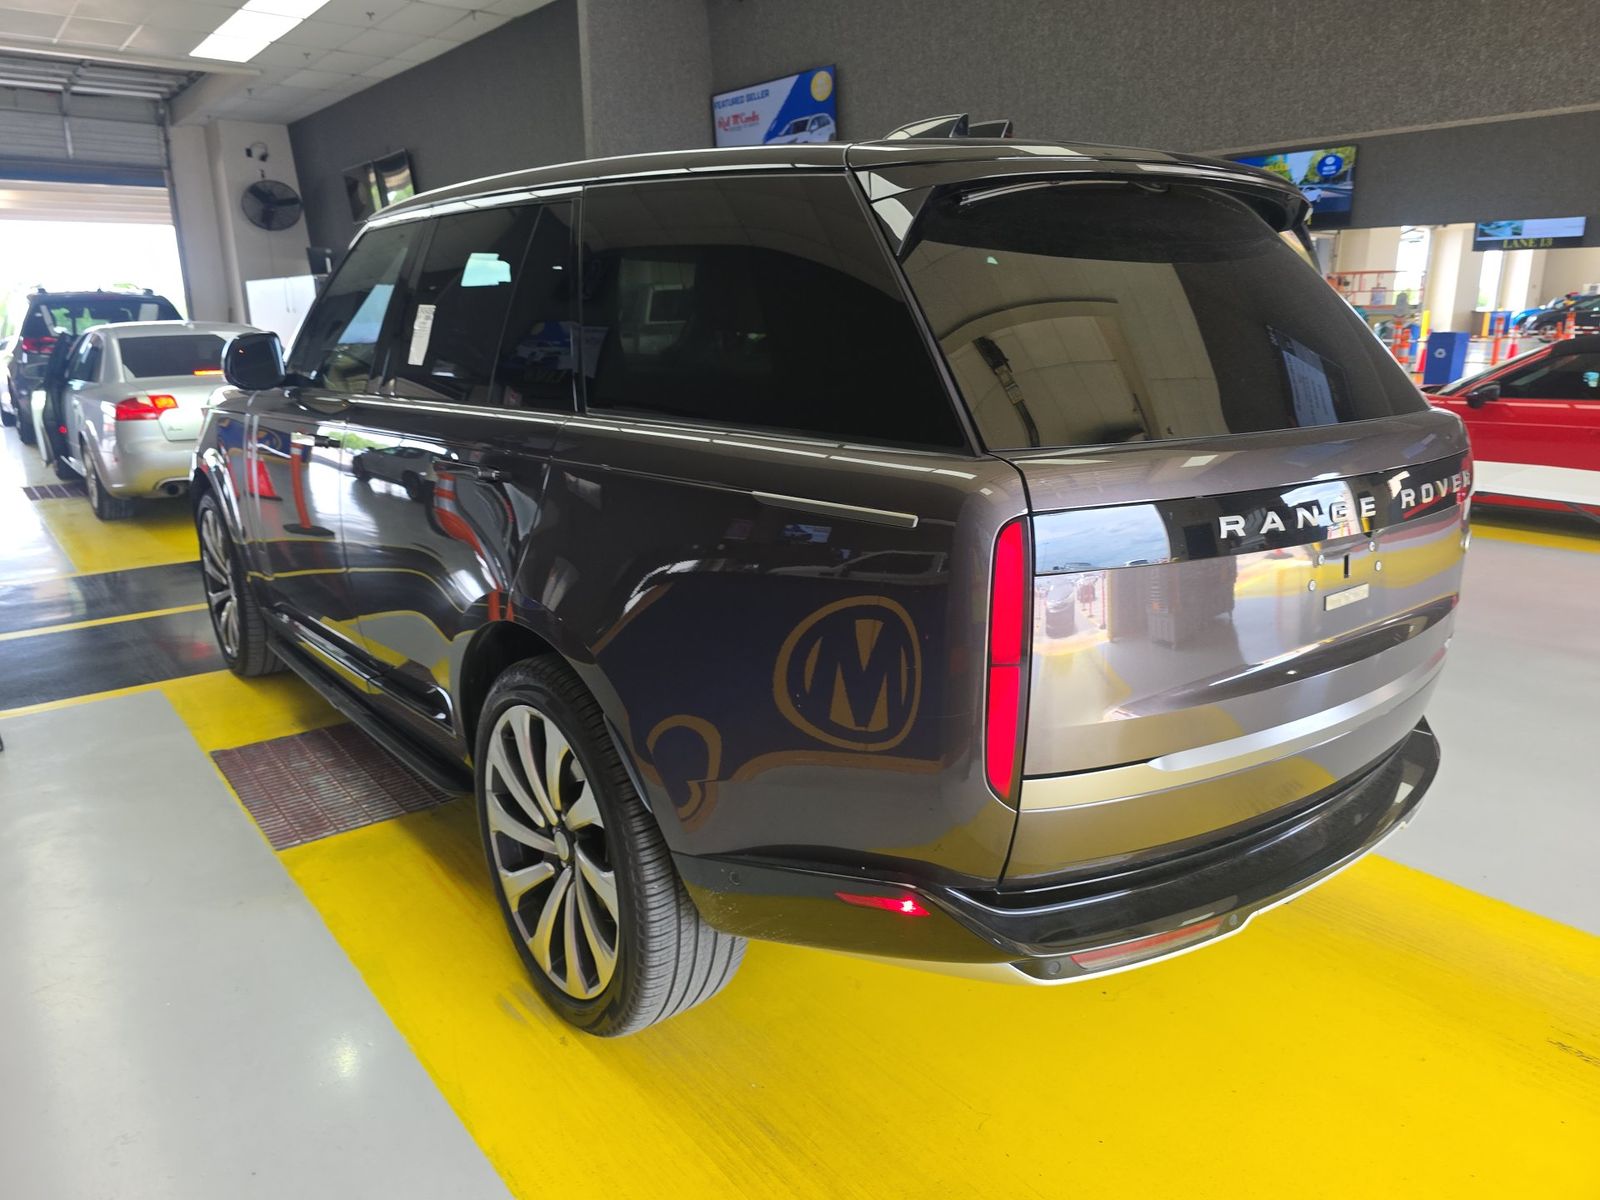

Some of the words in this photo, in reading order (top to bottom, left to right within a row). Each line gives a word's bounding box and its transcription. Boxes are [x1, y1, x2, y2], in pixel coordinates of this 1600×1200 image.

[714, 95, 744, 109] FEATURED
[746, 89, 769, 102] SELLER
[1503, 238, 1537, 249] LANE
[1219, 496, 1376, 540] RANGE
[1400, 470, 1471, 509] ROVER
